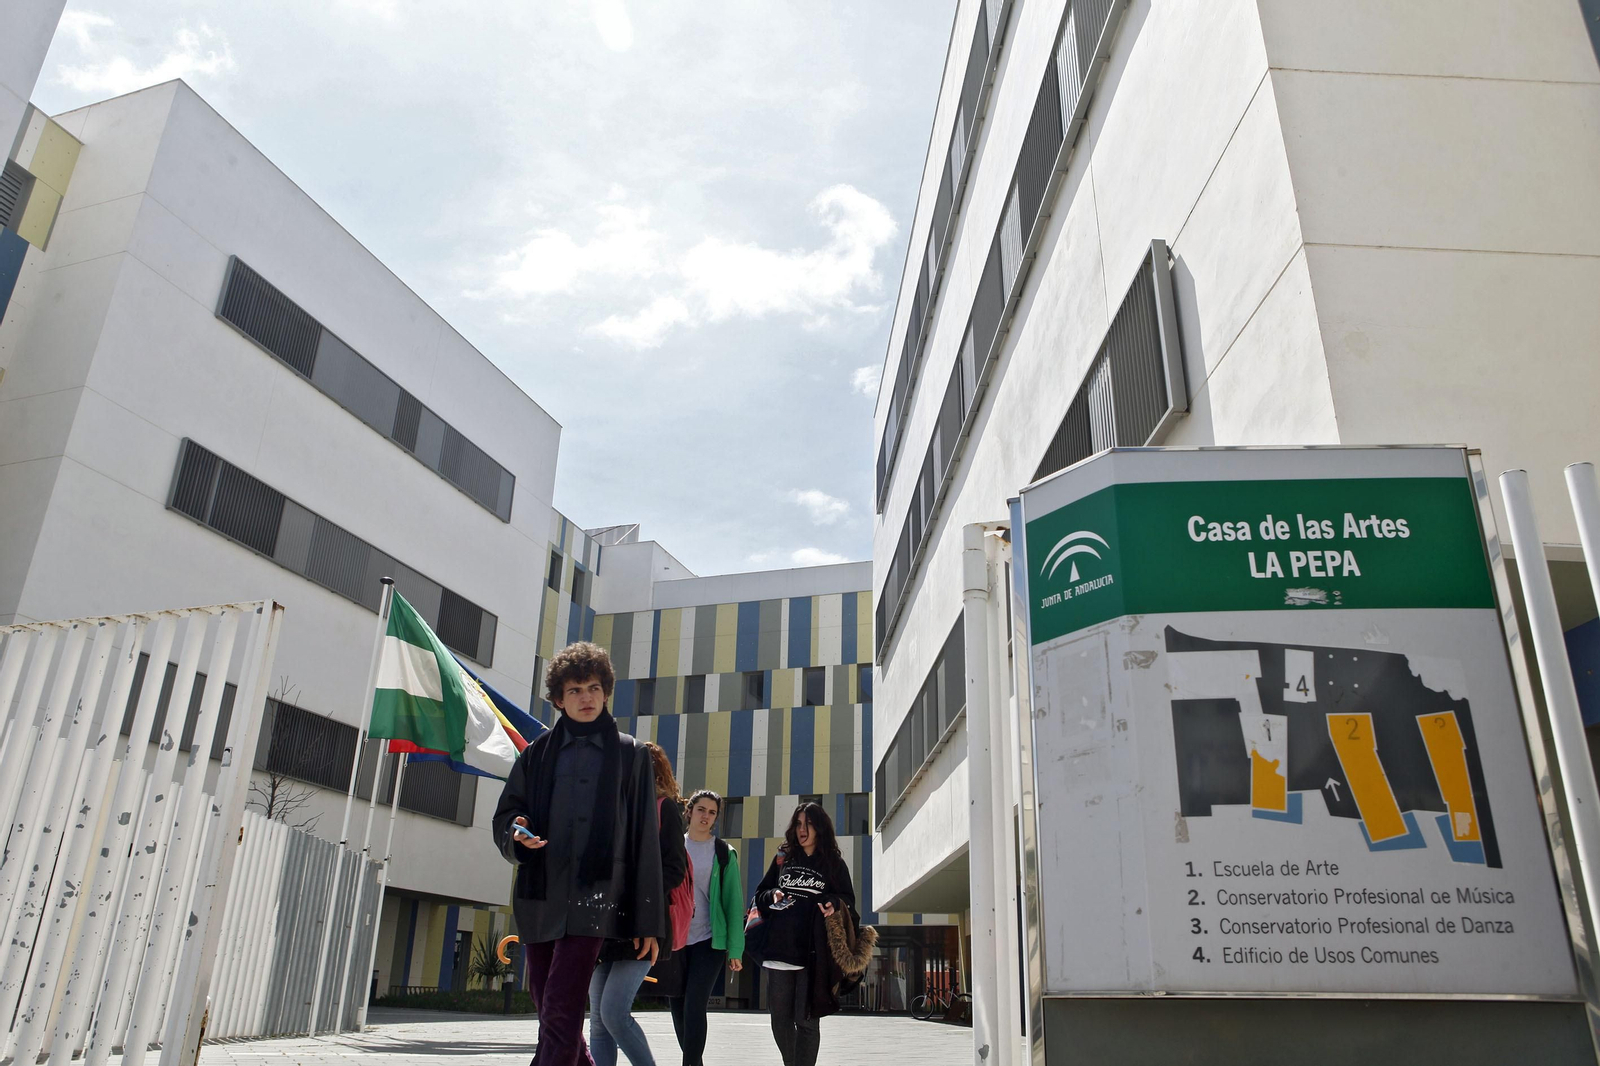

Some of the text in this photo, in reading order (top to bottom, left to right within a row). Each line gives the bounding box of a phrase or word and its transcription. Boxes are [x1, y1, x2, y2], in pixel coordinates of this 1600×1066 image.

[1187, 512, 1411, 542] Casa de las Artes
[1248, 550, 1362, 578] LA PEPA
[1041, 574, 1114, 609] JUNTA DE ANDALUCIA
[1296, 675, 1310, 697] 4
[1345, 717, 1361, 741] 2
[1184, 859, 1340, 878] 1. Escuela de Arte
[778, 874, 826, 890] Quiksilver
[1187, 889, 1206, 906] 2.
[1216, 888, 1329, 906] Conservatorio
[1334, 887, 1425, 905] Profesional
[1456, 887, 1516, 905] Música
[1190, 916, 1515, 935] 3. Conservatorio Profesional de Danza
[1192, 946, 1440, 964] 4. Edificio de Usos Comunes
